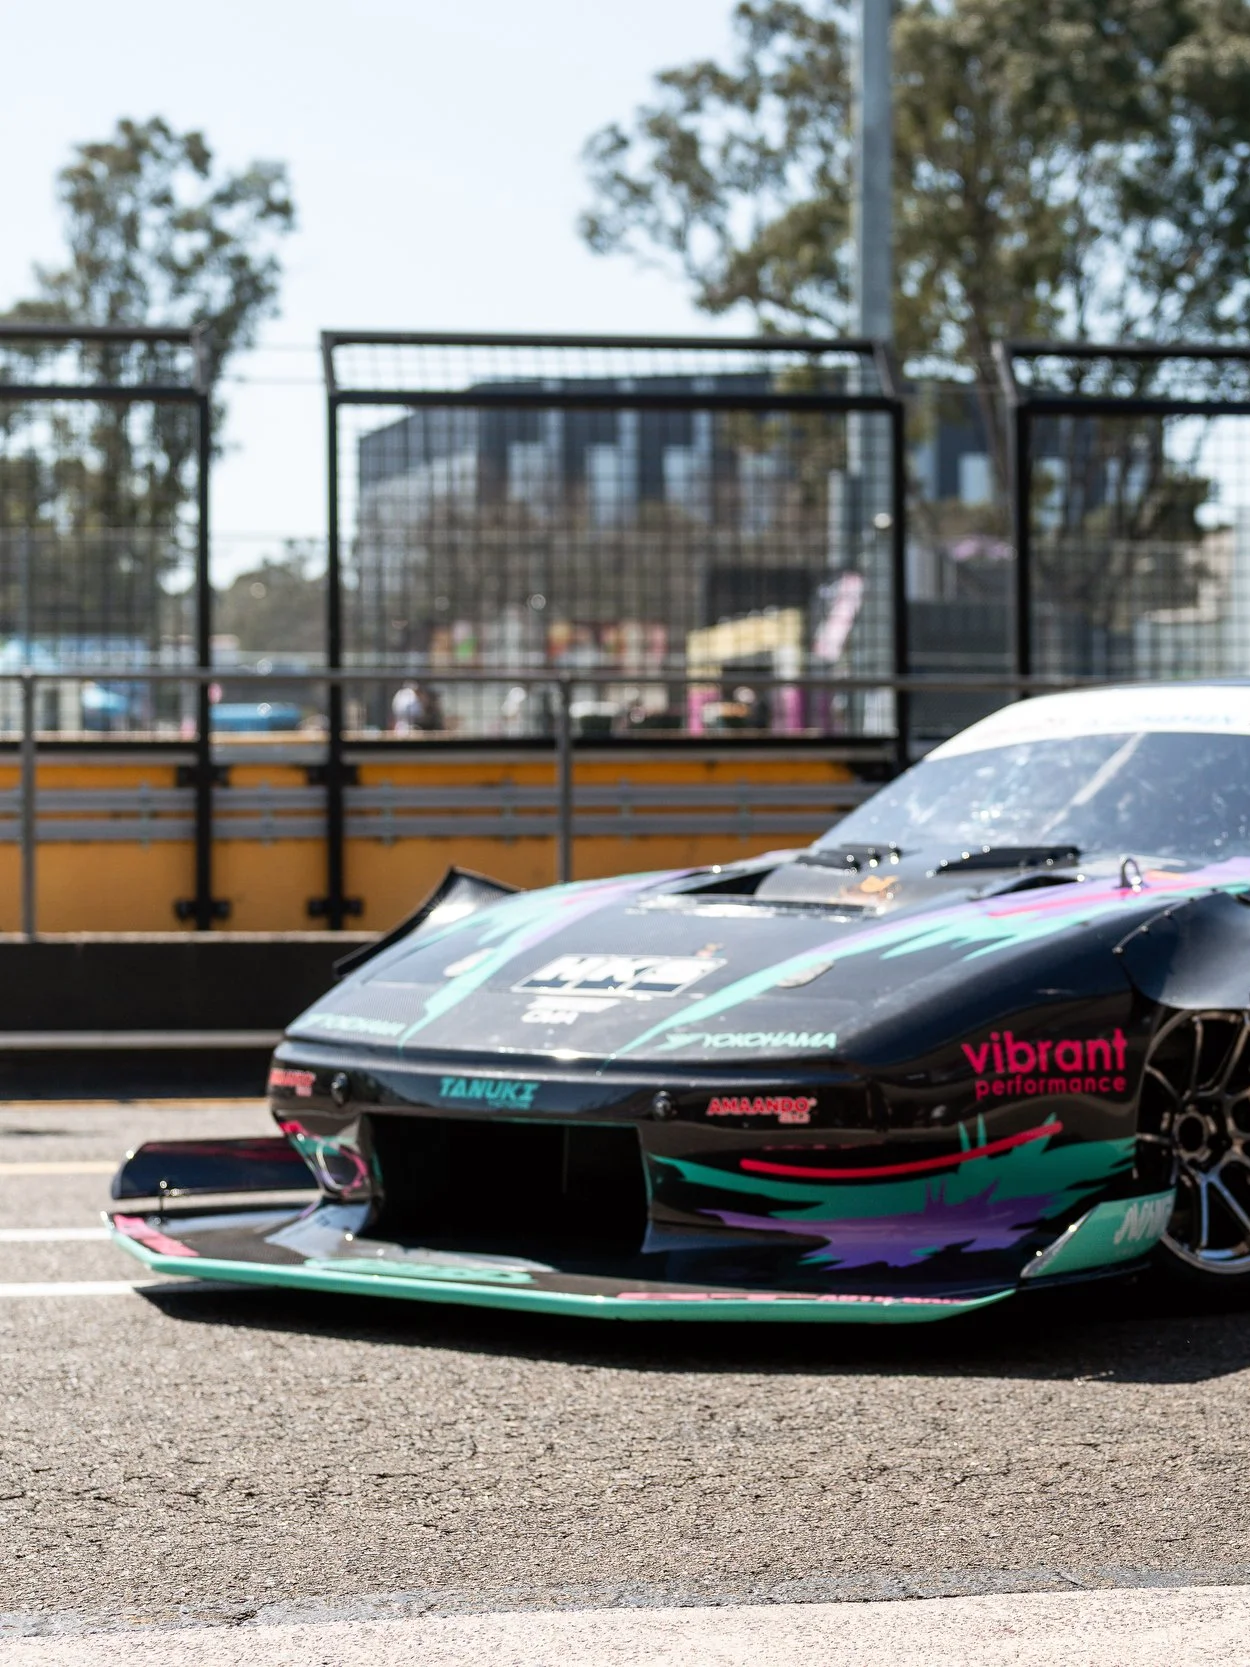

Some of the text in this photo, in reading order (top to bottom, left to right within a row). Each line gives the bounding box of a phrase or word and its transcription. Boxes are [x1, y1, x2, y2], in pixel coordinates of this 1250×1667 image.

[960, 1027, 1128, 1074] vibrant
[439, 1076, 540, 1101] TANUKI
[974, 1075, 1128, 1101] performance
